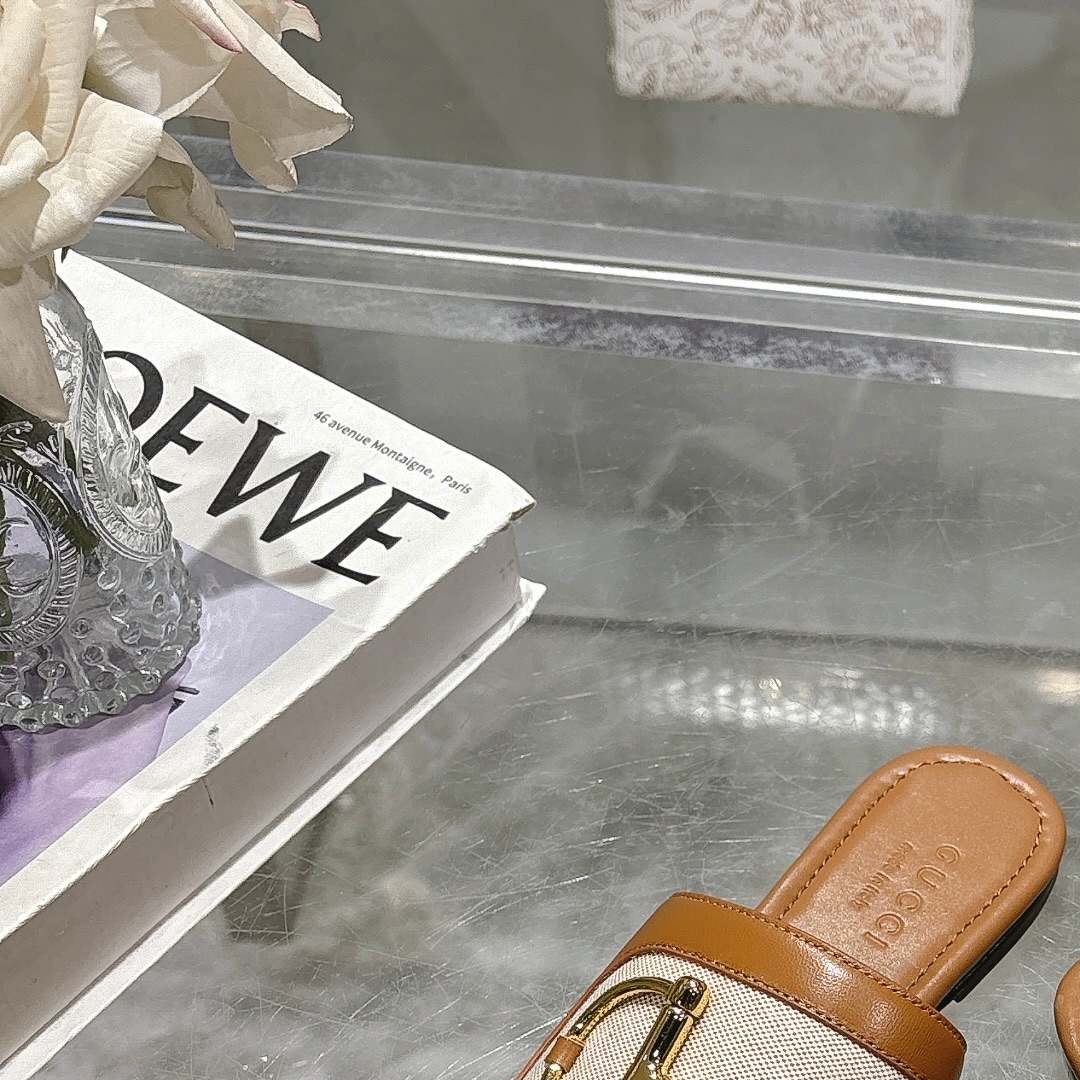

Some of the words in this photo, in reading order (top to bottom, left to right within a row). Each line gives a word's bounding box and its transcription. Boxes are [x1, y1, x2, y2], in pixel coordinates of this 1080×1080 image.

[102, 350, 450, 585] OEWE
[313, 410, 331, 424] 46
[328, 419, 372, 446] avenue
[371, 439, 435, 480] Montaigne,
[440, 474, 473, 495] Paris
[863, 843, 961, 949] GUCCI
